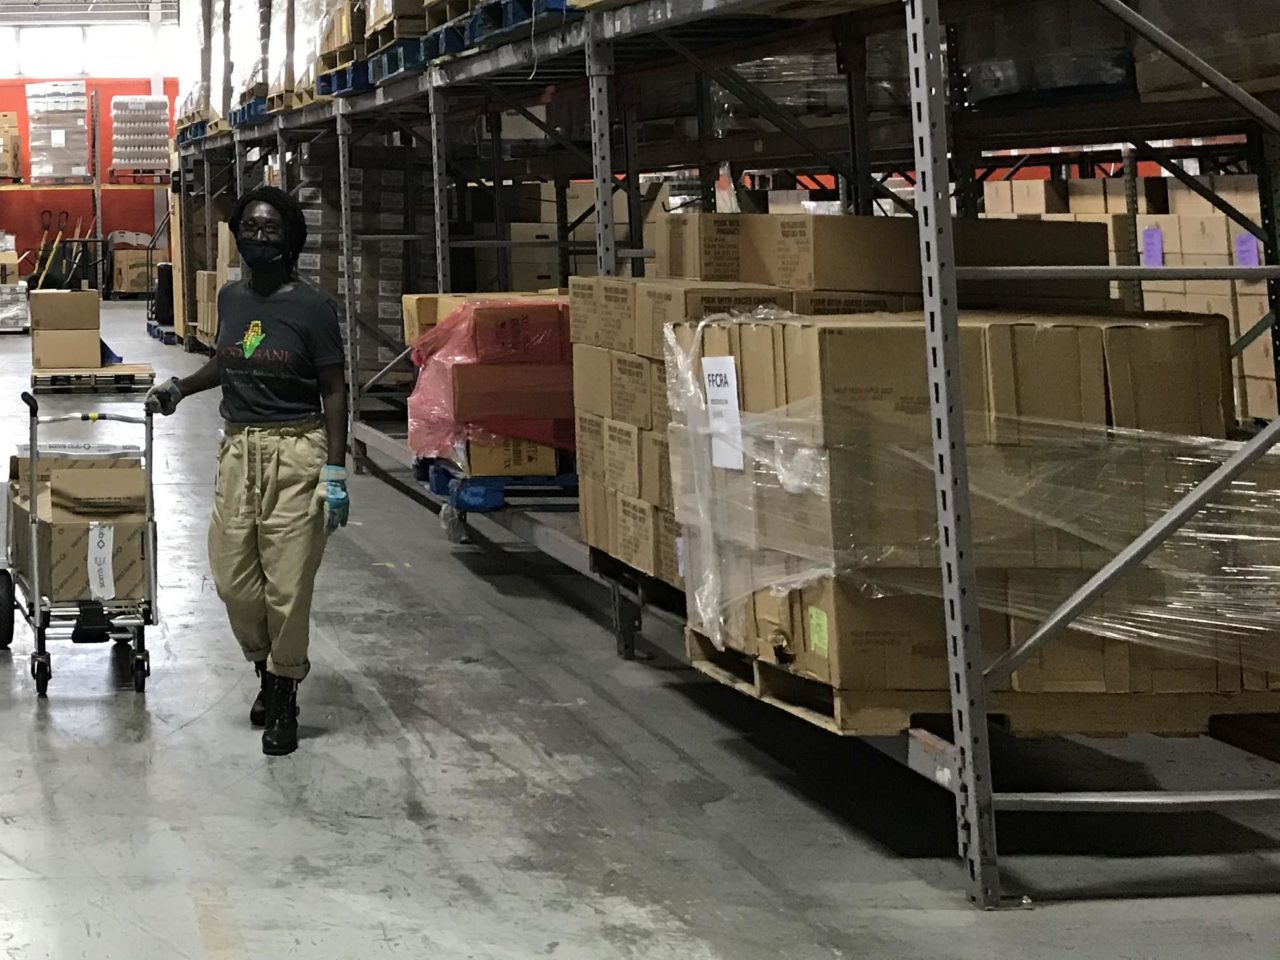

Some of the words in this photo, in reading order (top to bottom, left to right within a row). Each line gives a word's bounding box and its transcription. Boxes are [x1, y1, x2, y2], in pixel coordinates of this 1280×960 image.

[701, 296, 716, 304] PORK
[717, 296, 732, 305] WITH
[707, 373, 729, 388] FFCRA
